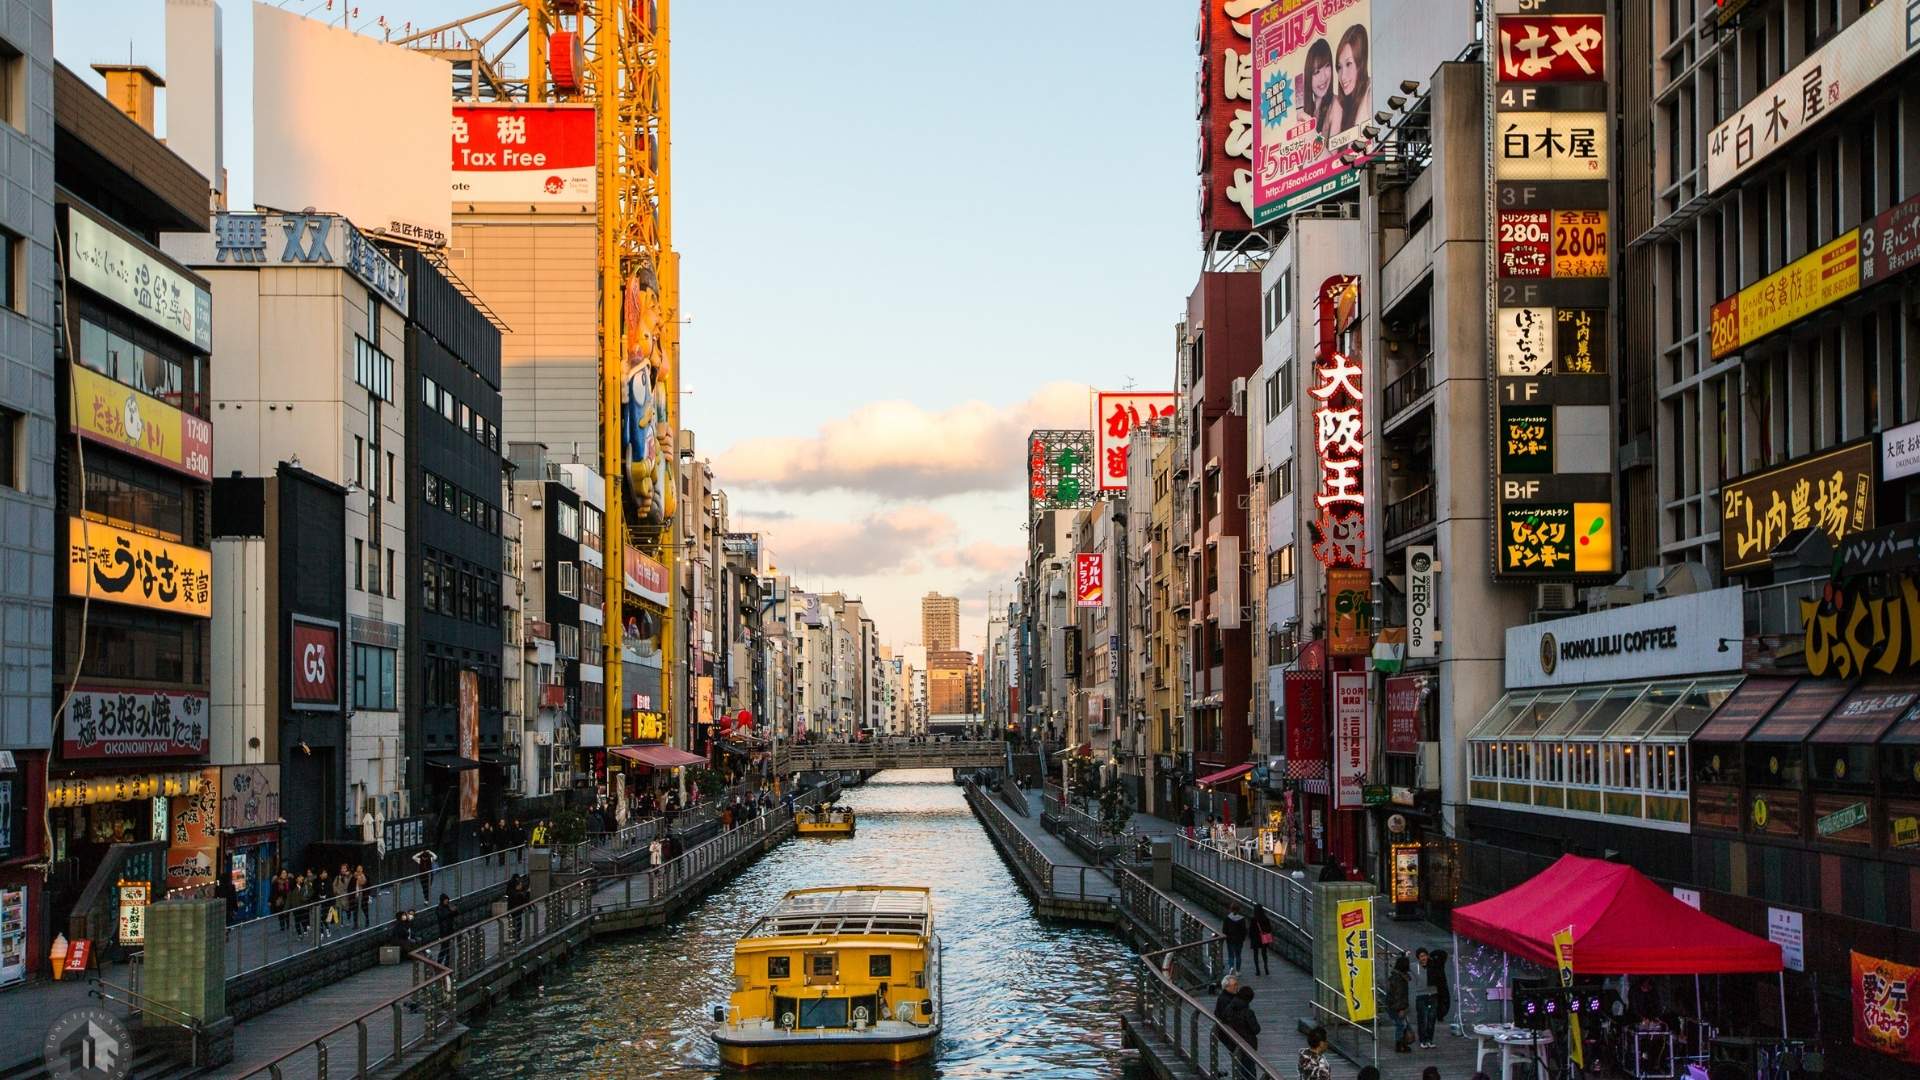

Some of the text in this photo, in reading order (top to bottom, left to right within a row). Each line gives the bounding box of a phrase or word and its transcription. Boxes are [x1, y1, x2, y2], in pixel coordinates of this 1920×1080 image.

[1264, 5, 1326, 65] 高収入
[1501, 24, 1602, 78] はや
[1736, 65, 1825, 170] 白木屋
[1503, 123, 1598, 159] 白木屋
[1712, 125, 1729, 156] 4F
[461, 148, 546, 167] Tax Free
[1502, 187, 1537, 205] 3F
[390, 220, 445, 241] 意匠作成中
[1500, 223, 1549, 243] 280円
[1501, 213, 1547, 223] ドリンク全品
[1559, 211, 1601, 225] 全品
[216, 215, 333, 263] 無双
[1555, 226, 1607, 257] 280円
[1503, 285, 1538, 303] 2F
[1558, 311, 1573, 321] 2F
[1516, 309, 1540, 373] ぼてぢゅう
[1575, 310, 1591, 373] 山内農場
[1543, 367, 1552, 375] 2F
[1505, 382, 1538, 401] 1F
[187, 418, 208, 444] 17:00
[1310, 354, 1365, 569] 大阪王将
[1508, 440, 1547, 455] ドンキー
[1504, 481, 1540, 499] B1F
[1725, 489, 1744, 520] 2F
[1737, 470, 1849, 560] 山内農場
[1511, 519, 1566, 546] びっくり
[1508, 544, 1570, 568] ドンキー
[1844, 530, 1920, 567] ハンバー
[93, 536, 179, 603] うなぎ
[1079, 562, 1089, 593] ドラッグ
[1089, 556, 1100, 585] ツルハ
[1412, 575, 1426, 616] ZERO
[1560, 625, 1678, 661] HONOLULU COFFEE
[303, 643, 326, 684] G3
[1340, 687, 1364, 695] 300円
[98, 693, 171, 738] お好み焼
[104, 742, 168, 755] OKONOMIYAKI
[1350, 716, 1361, 768] 三日月百子
